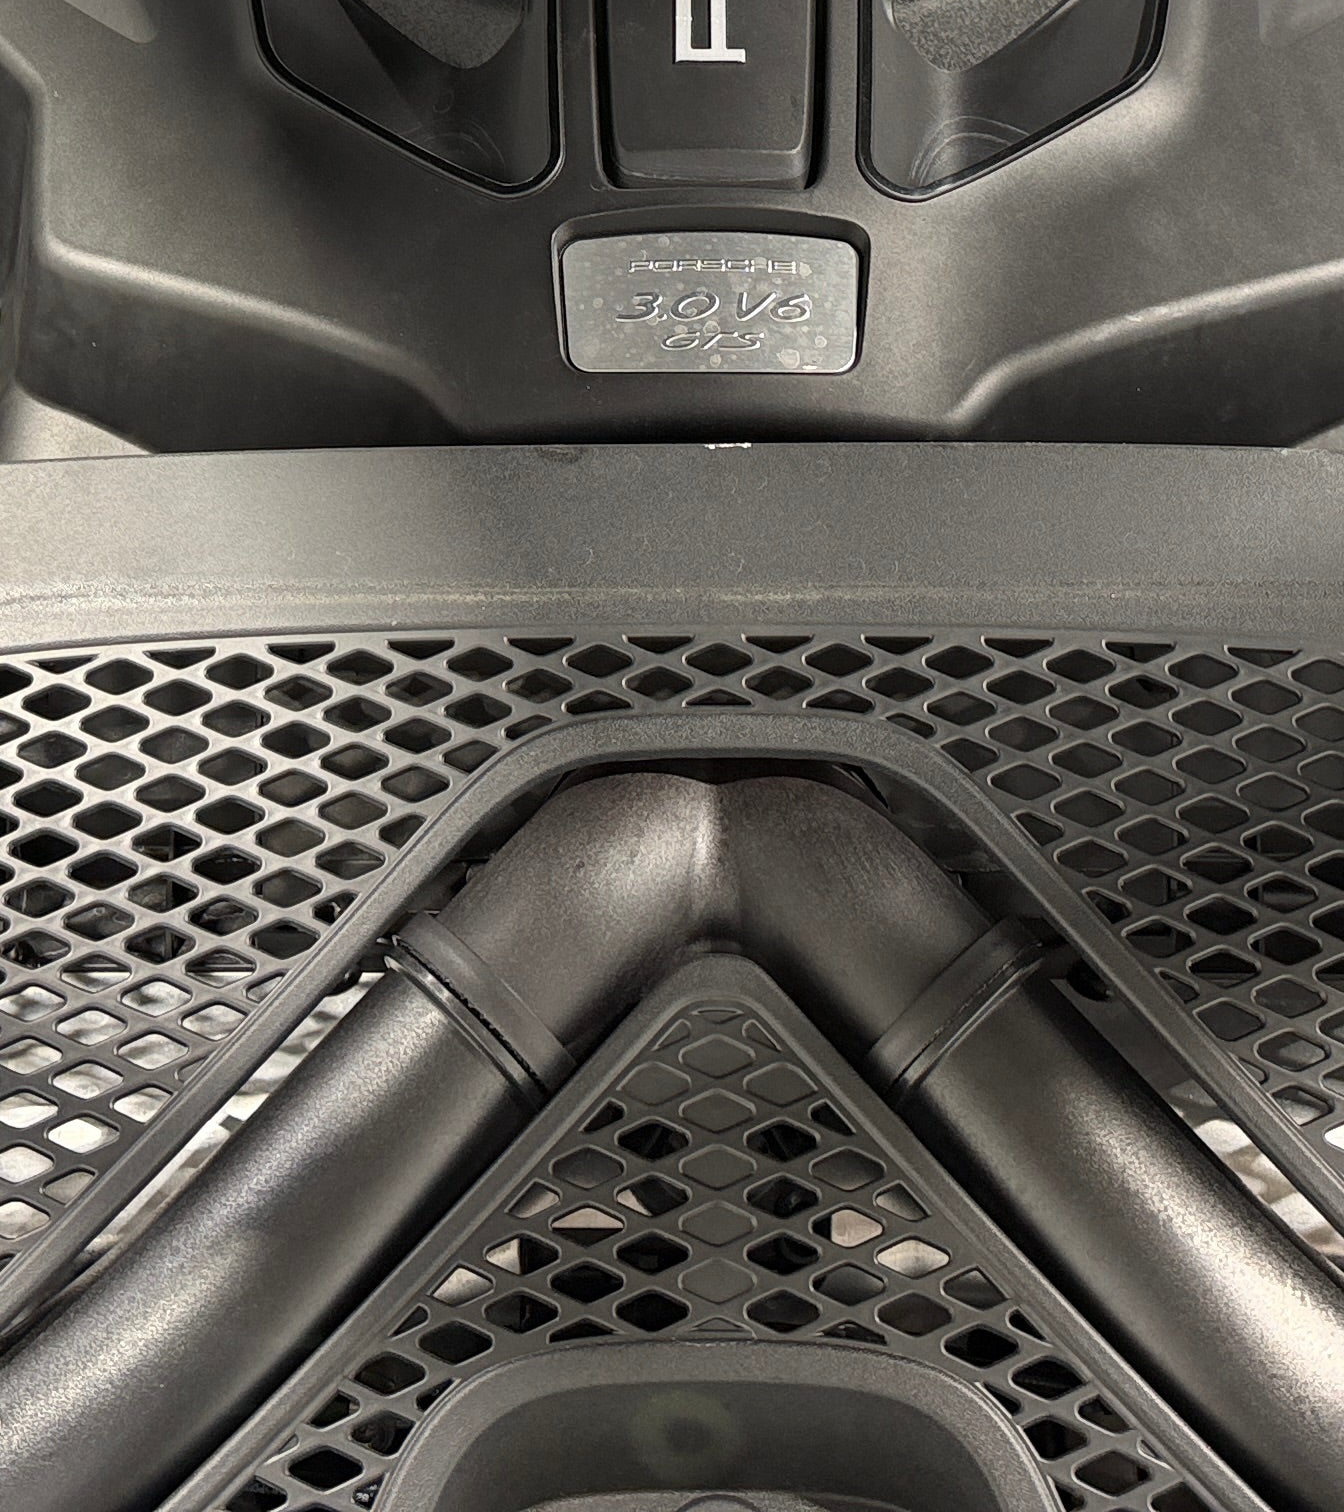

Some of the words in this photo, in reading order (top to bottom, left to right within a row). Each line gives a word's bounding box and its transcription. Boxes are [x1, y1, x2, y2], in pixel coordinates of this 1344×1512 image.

[629, 258, 798, 274] PORSCHE
[615, 292, 721, 323] 3.0
[735, 292, 812, 322] V6
[660, 332, 765, 351] GTS
